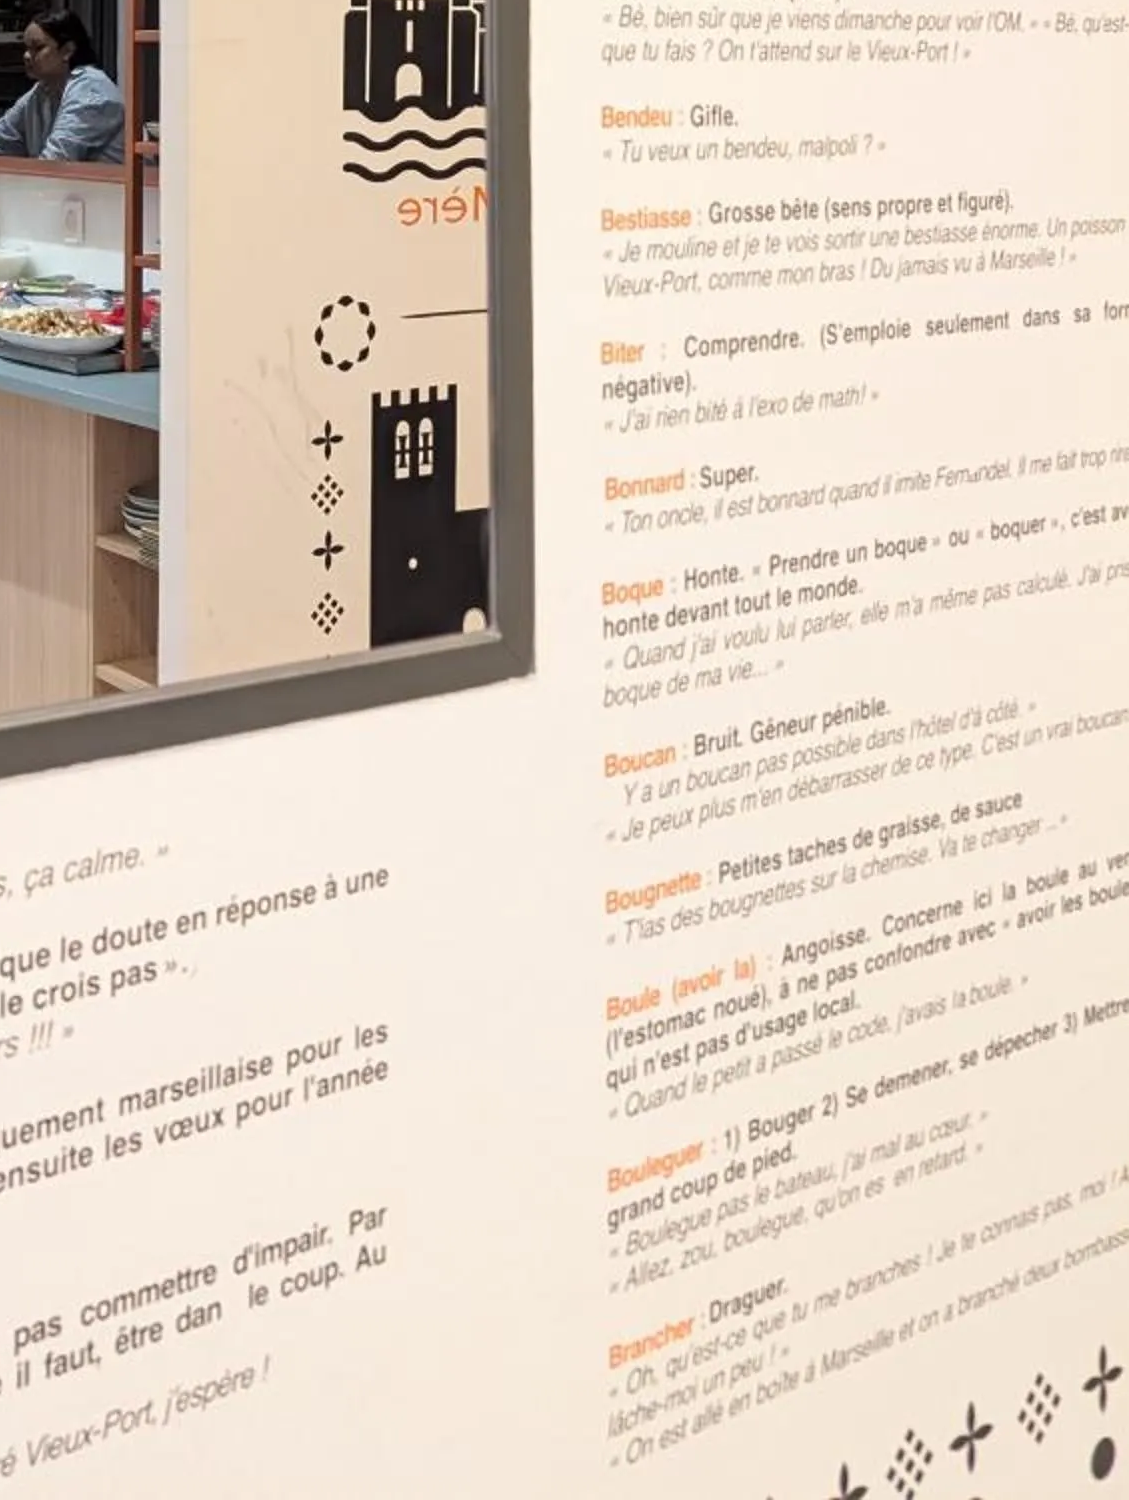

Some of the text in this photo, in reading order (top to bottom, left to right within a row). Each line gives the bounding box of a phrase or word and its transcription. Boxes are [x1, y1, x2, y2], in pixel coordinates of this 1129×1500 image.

[604, 726, 742, 777] Boucan Bruit.
[605, 792, 1022, 914] Bougnette Petites taches de graisse, de sauce
[60, 936, 82, 962] le
[91, 918, 167, 955] doute
[176, 910, 206, 935] en
[216, 884, 316, 926] réponse
[346, 868, 388, 894] une
[0, 991, 22, 1017] le
[32, 972, 100, 1009] crois
[110, 961, 156, 996] pas
[606, 928, 870, 1020] Boule (avoir la) Angoisse.
[105, 1131, 142, 1160] les
[154, 1107, 224, 1144] vœux
[236, 1087, 292, 1128] pour
[303, 1060, 388, 1101] l'année
[119, 1056, 273, 1116] marseillaise
[286, 1036, 341, 1075] pour
[355, 1024, 387, 1049] les
